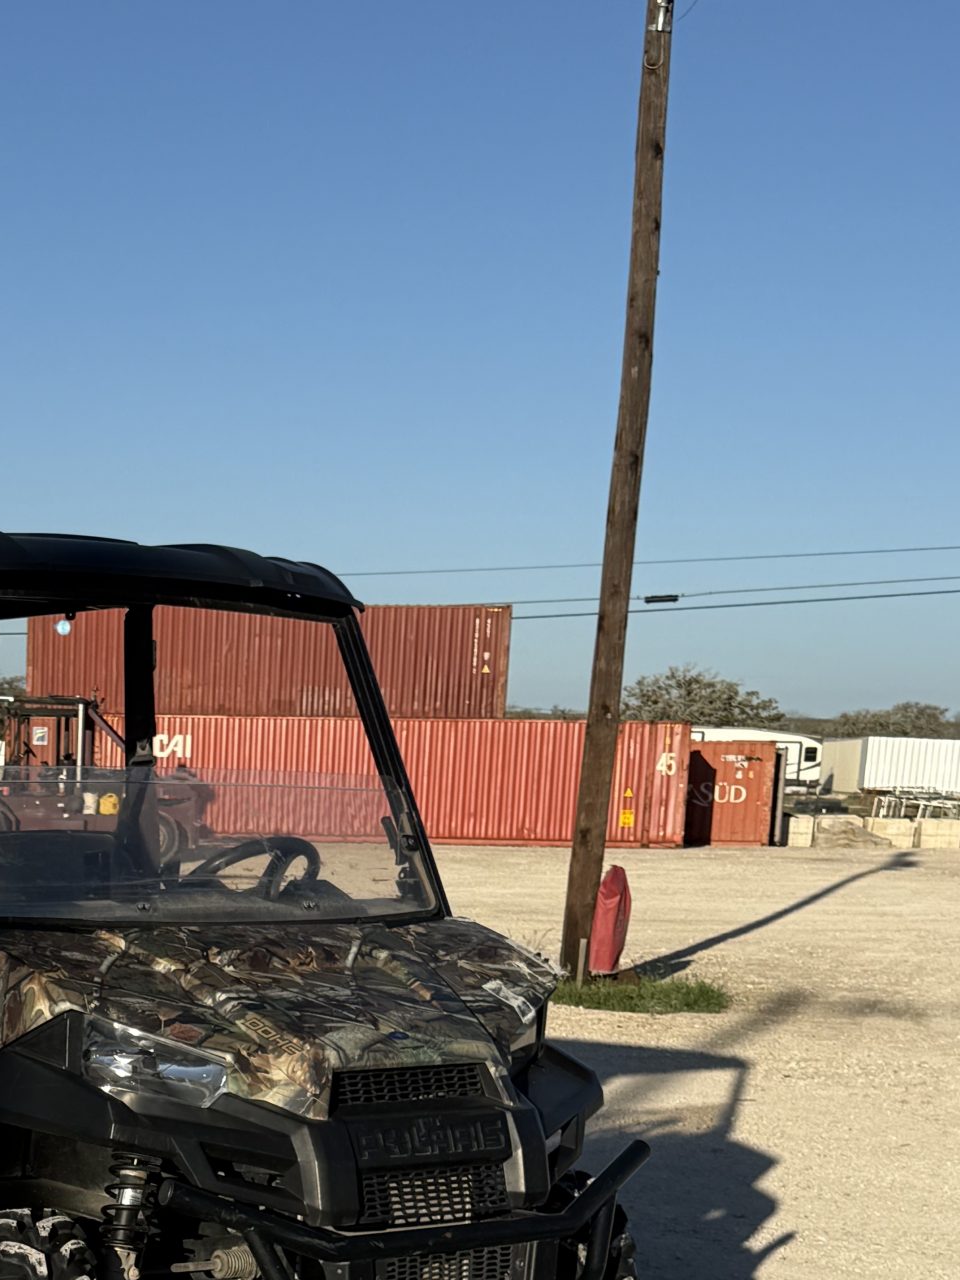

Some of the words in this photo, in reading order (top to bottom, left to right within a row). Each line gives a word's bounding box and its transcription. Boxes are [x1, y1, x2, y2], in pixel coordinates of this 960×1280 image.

[152, 734, 192, 758] CAI
[656, 753, 676, 775] 45
[359, 1120, 506, 1159] POLARIS
